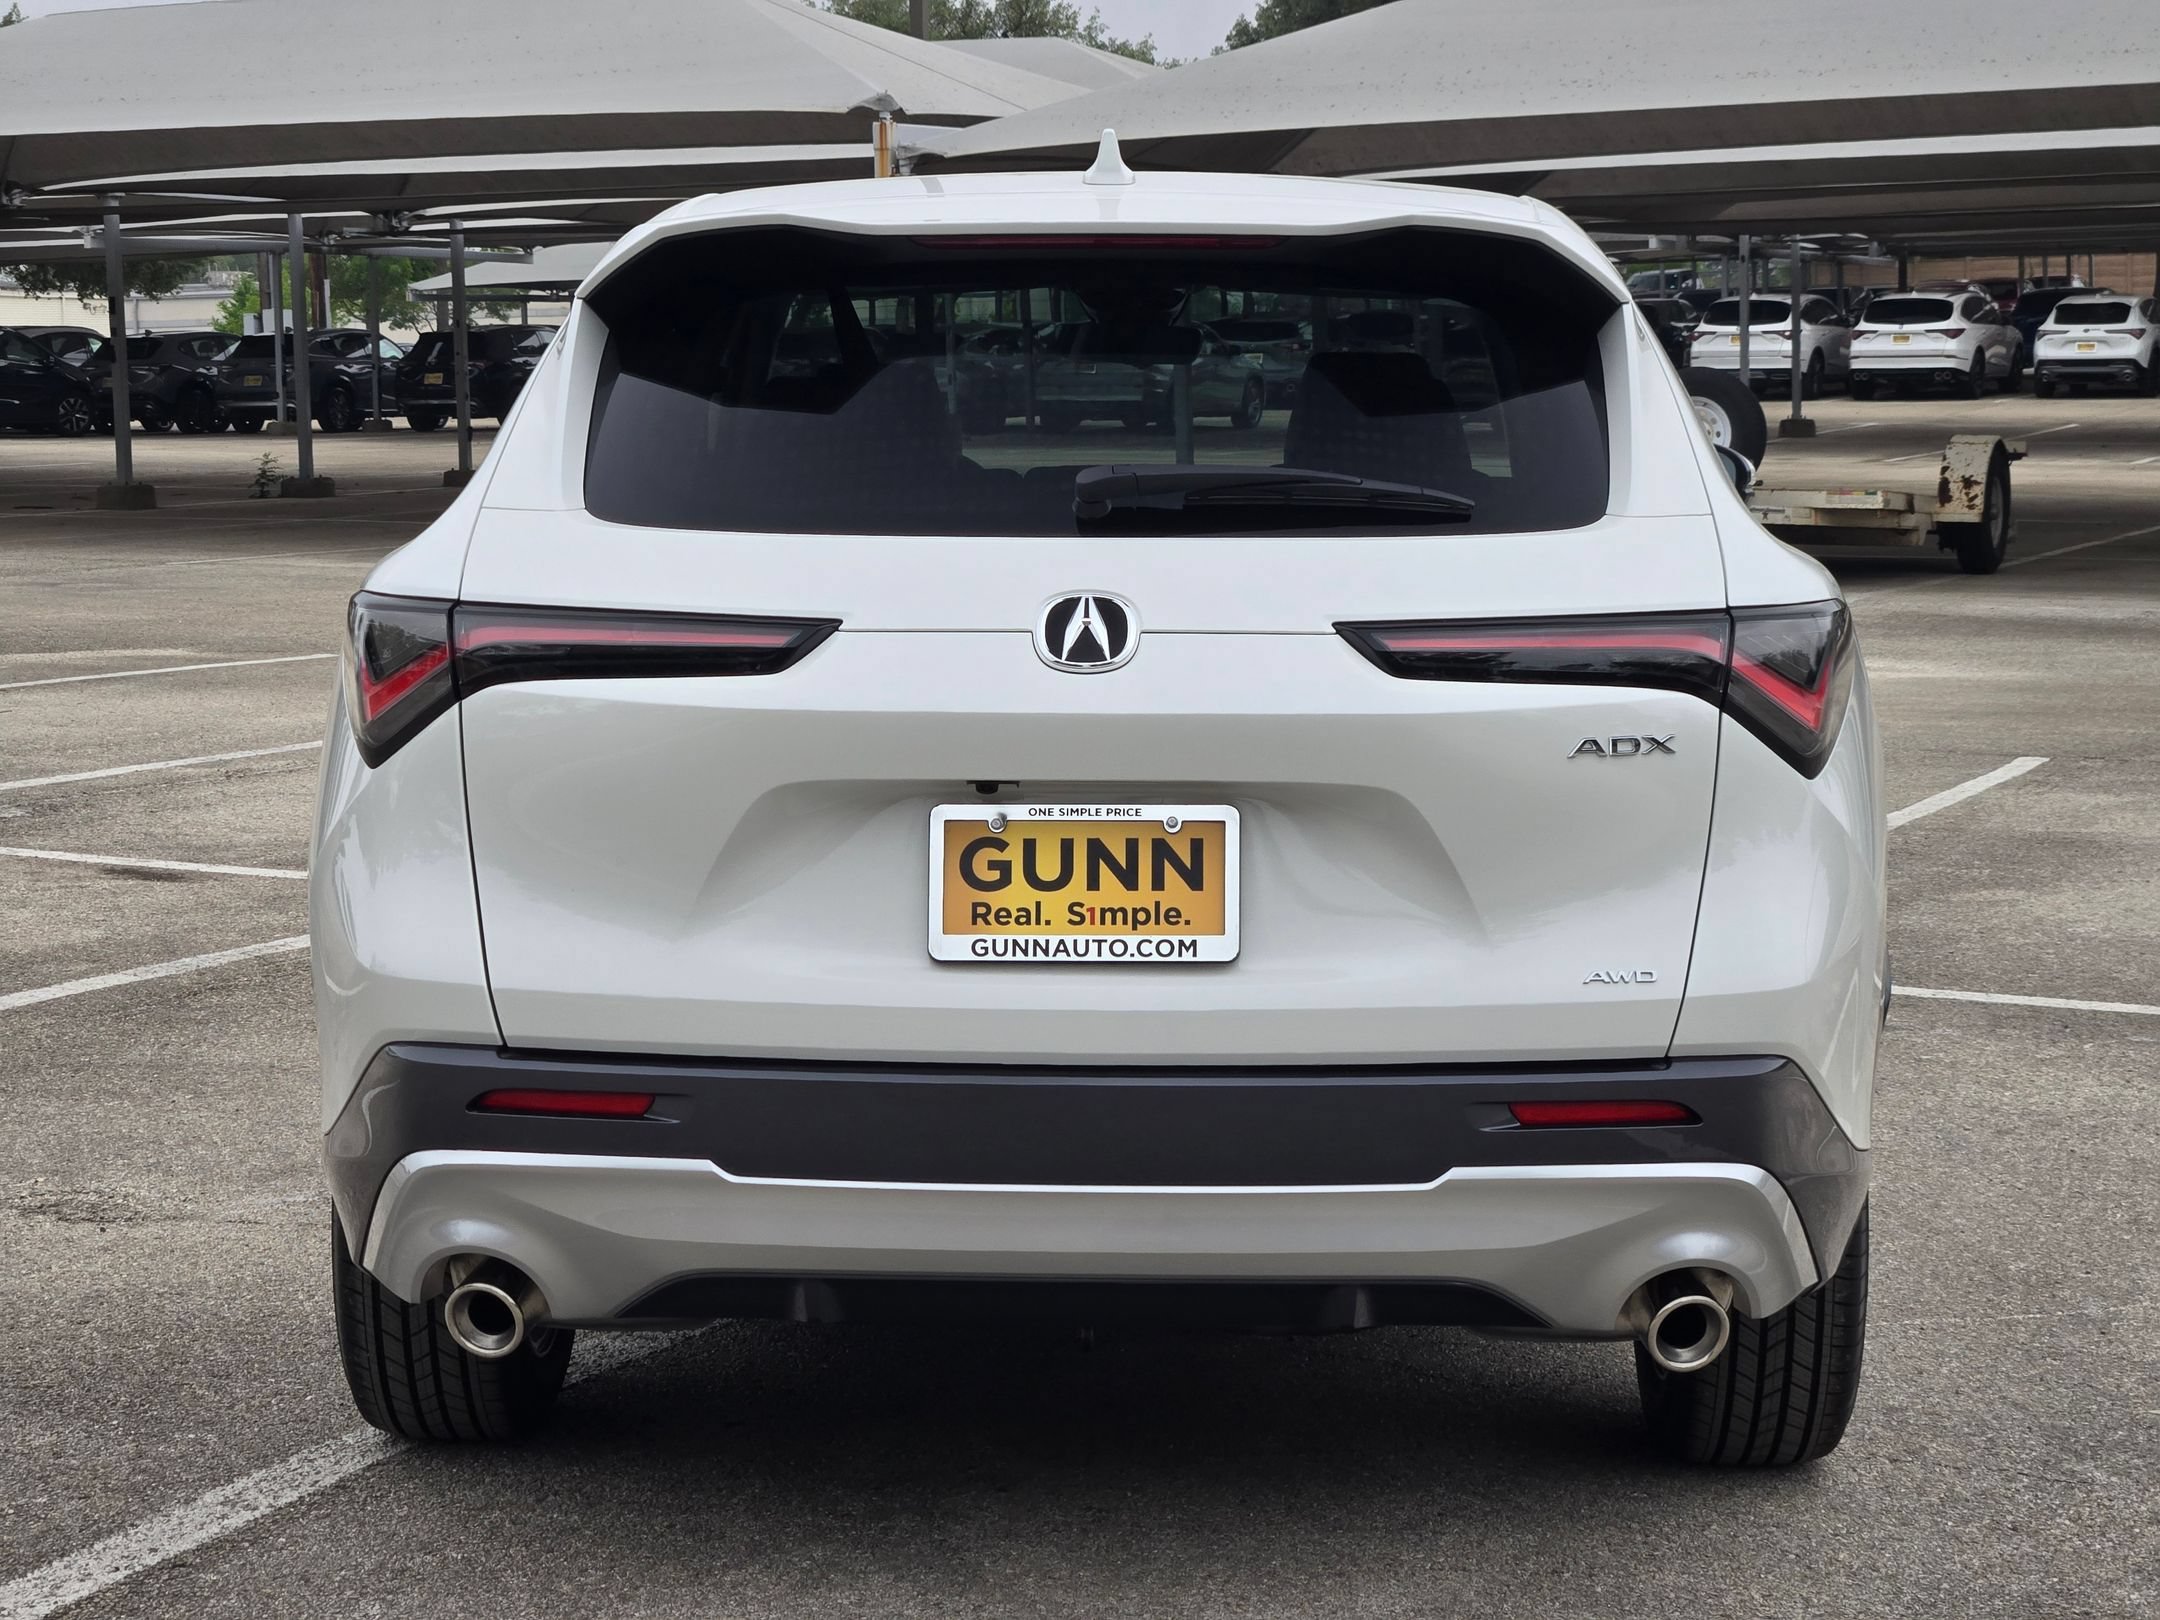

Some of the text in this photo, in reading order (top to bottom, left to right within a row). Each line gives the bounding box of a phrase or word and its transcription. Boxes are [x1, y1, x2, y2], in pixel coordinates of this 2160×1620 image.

[1567, 734, 1676, 759] ADX
[1028, 807, 1142, 817] ONE SIMPLE PRICE
[959, 836, 1204, 892] GUNN
[971, 901, 1051, 926] Real.
[970, 938, 1198, 958] GUNNAUTO.COM
[1582, 969, 1657, 984] AWD
